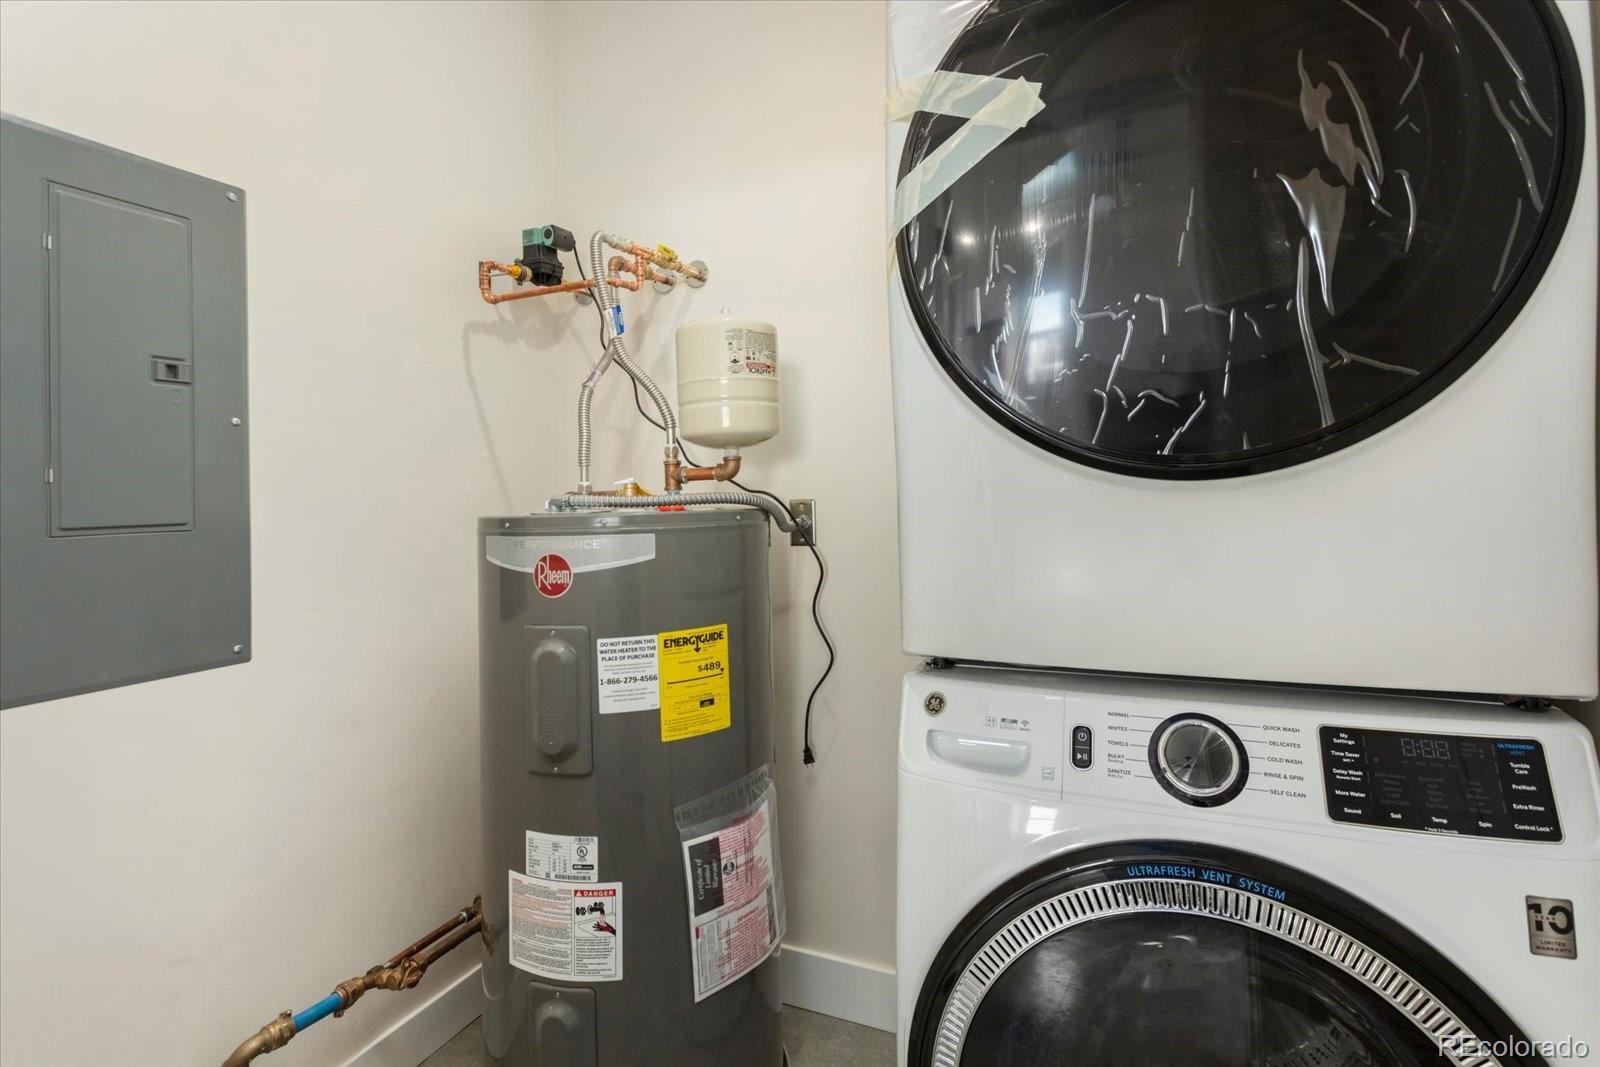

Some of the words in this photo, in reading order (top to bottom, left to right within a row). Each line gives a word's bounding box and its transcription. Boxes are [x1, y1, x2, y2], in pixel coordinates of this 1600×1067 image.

[538, 553, 570, 591] Rheem
[663, 630, 725, 651] ENERGYGUIDE
[697, 661, 721, 673] $489
[600, 674, 658, 686] 1-866-279-4566
[1268, 740, 1301, 748] DELICATES
[1285, 790, 1307, 798] CLEAN
[1431, 816, 1448, 824] Temp
[1478, 820, 1493, 828] Spin
[1514, 823, 1536, 831] Control
[703, 864, 712, 889] Limited
[1126, 865, 1196, 878] ULTRAFRESH
[1201, 868, 1233, 884] VENT
[1239, 877, 1286, 901] SYSTEM
[1527, 903, 1574, 935] 10
[1536, 945, 1572, 953] WARRANTY
[1540, 940, 1567, 948] LIMITED
